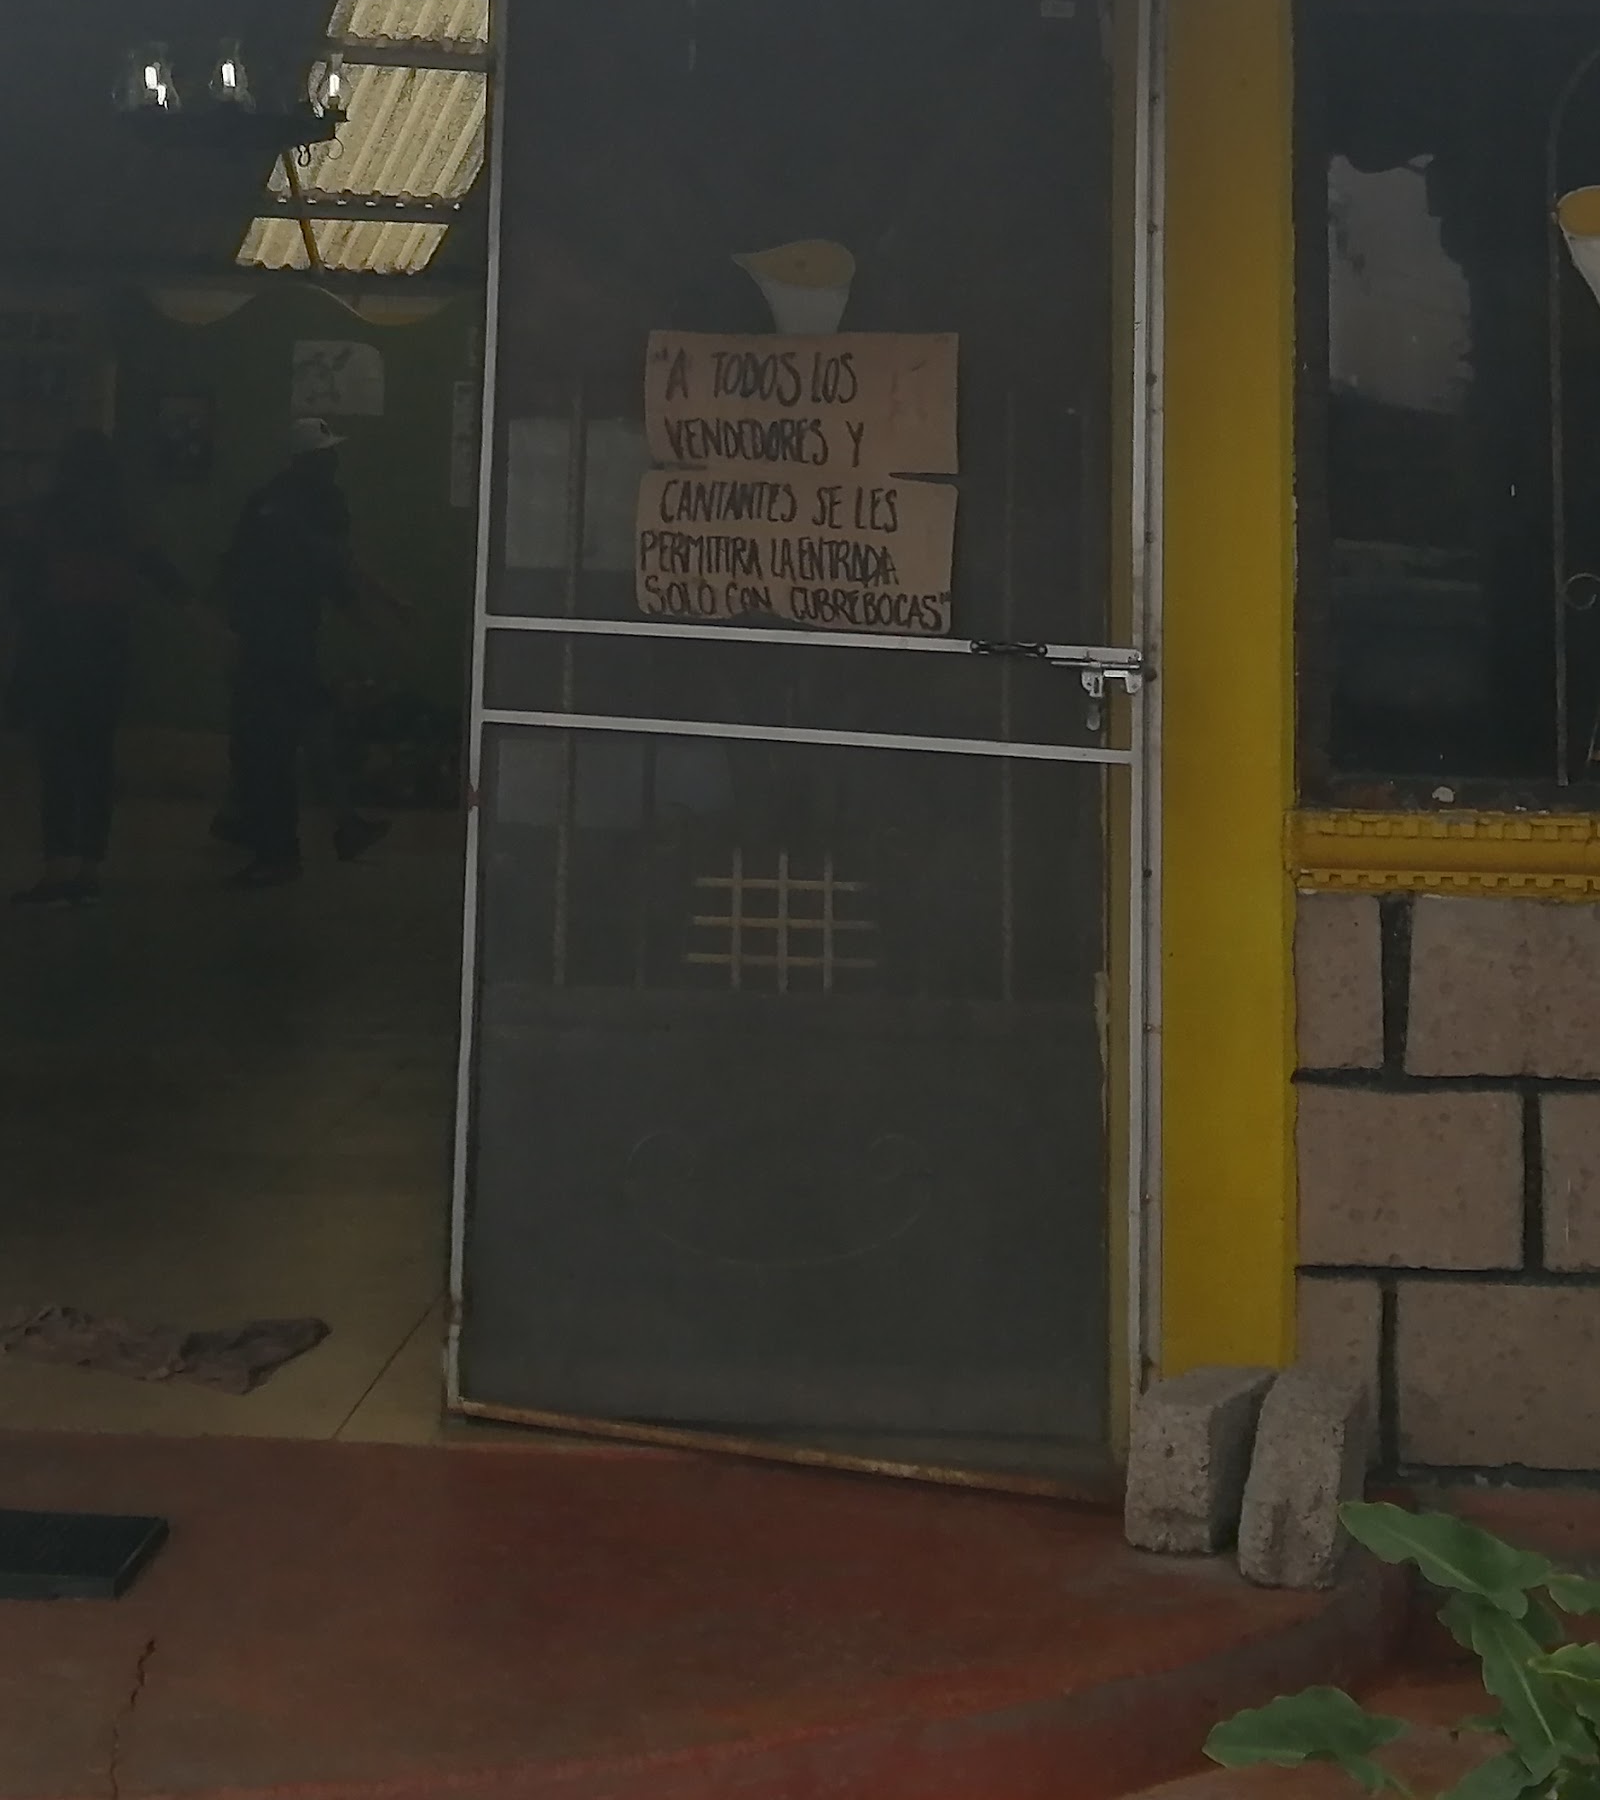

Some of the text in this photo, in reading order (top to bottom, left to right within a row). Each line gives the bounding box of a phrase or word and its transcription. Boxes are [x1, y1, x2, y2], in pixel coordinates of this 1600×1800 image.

[712, 352, 800, 407] TODOS
[811, 351, 858, 404] LOS
[664, 417, 865, 468] VENDEDORES Y
[659, 479, 898, 534] CANTANTES SE LES
[770, 537, 797, 582] LA
[798, 537, 900, 588] ENTRADA
[644, 575, 718, 616] SOLO
[725, 582, 773, 615] CON
